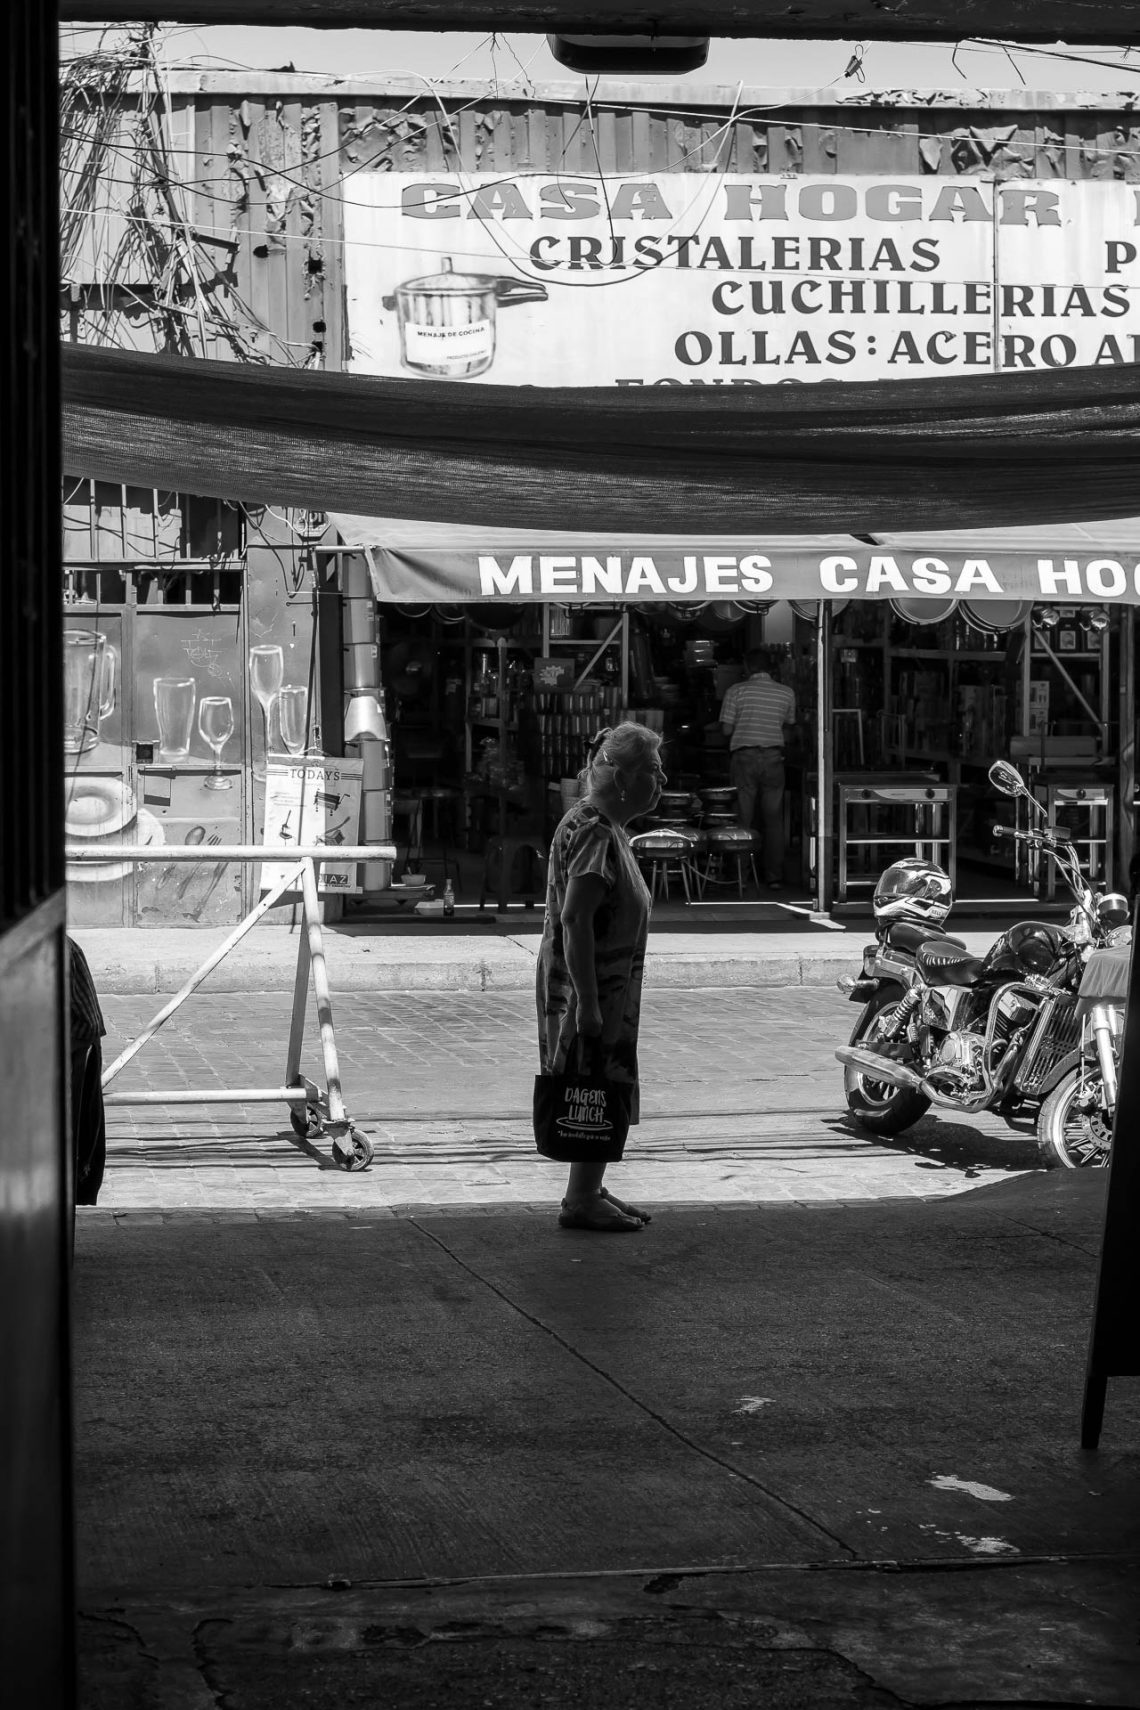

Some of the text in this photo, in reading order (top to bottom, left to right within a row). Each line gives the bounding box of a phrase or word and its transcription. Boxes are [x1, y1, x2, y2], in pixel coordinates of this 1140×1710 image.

[402, 182, 1062, 228] CASA HOGAR
[530, 235, 940, 272] CRISTALERIAS
[713, 280, 1130, 318] CUCHILLERIAS
[479, 556, 1140, 598] MENAJES CASA HO
[291, 769, 340, 781] TODAYS
[564, 1087, 607, 1108] DAGENS
[568, 1104, 605, 1123] LUNCH
